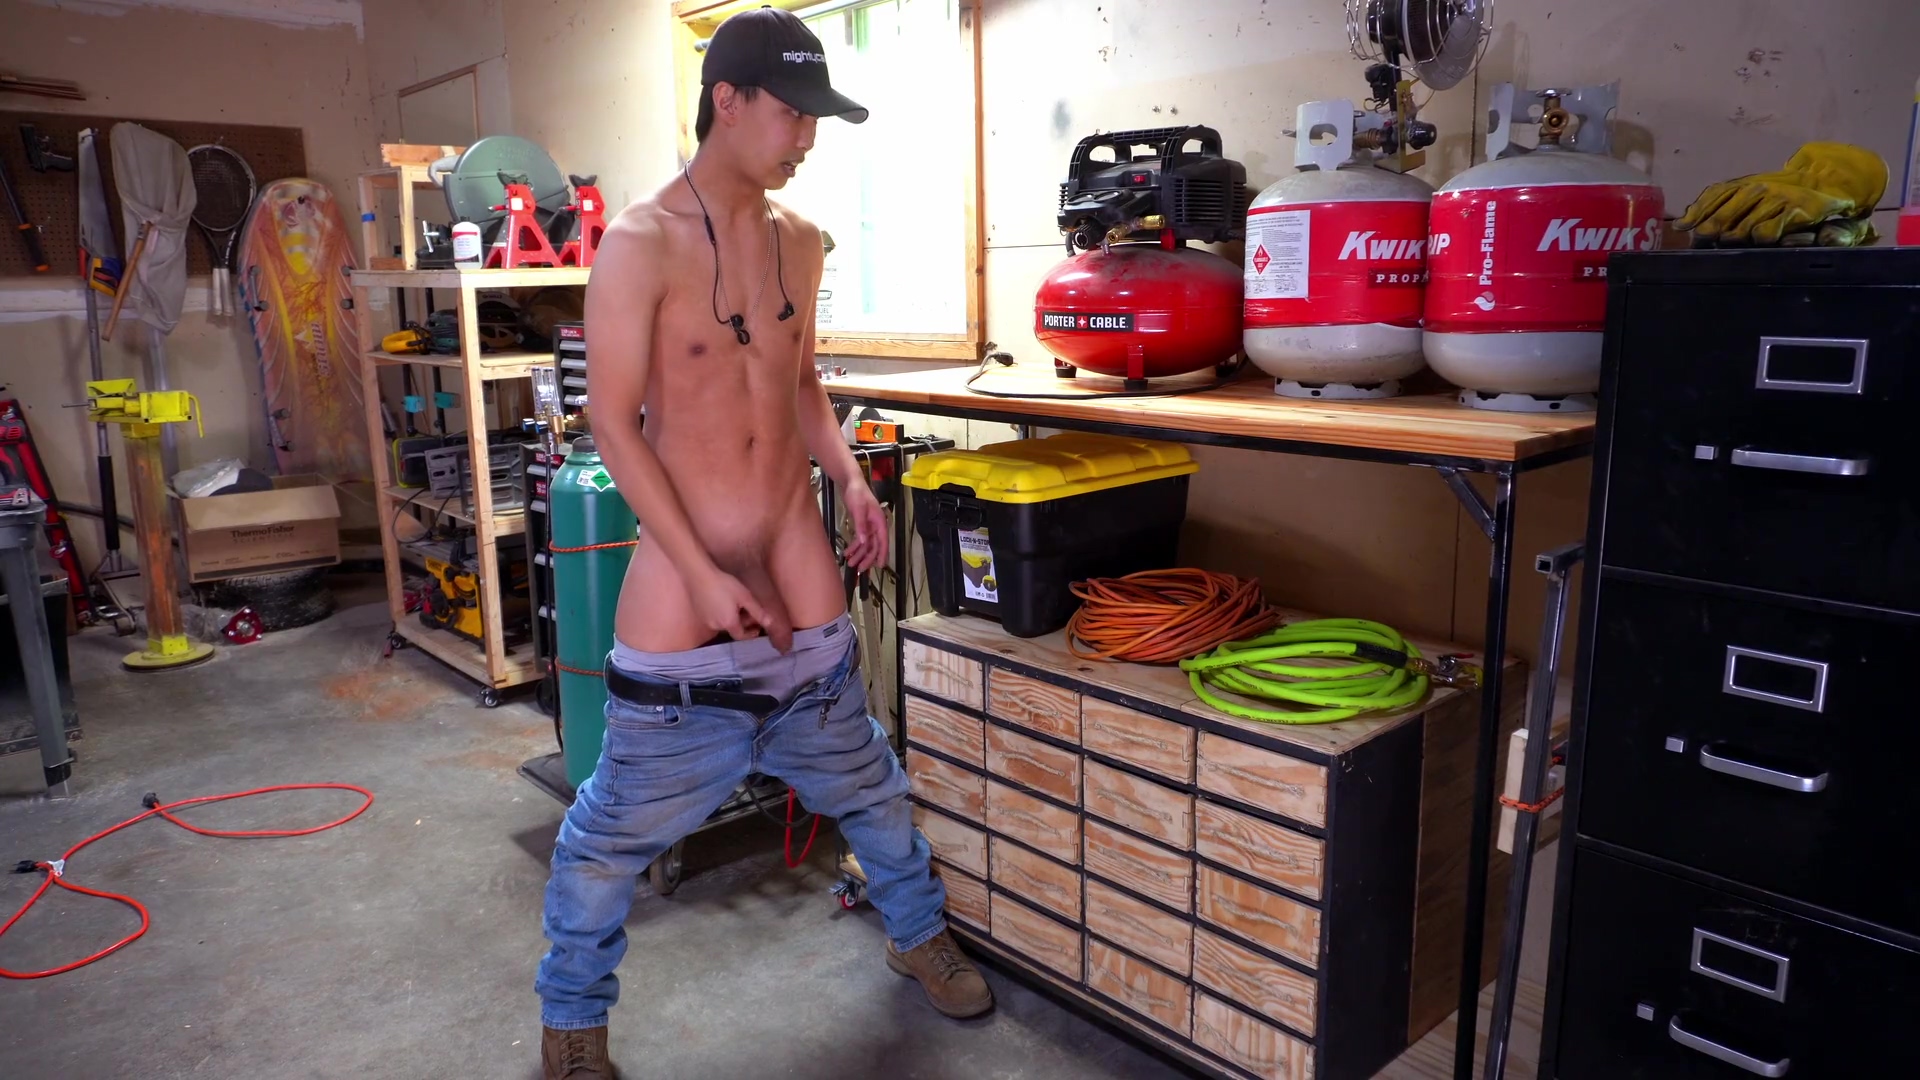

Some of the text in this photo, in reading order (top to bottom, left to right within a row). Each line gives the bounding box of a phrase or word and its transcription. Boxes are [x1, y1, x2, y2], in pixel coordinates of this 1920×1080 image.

[1338, 231, 1426, 260] KWIK
[1479, 200, 1496, 285] Pro-Flame
[1537, 218, 1641, 251] KWIK
[1044, 314, 1126, 329] PORTER CABLE
